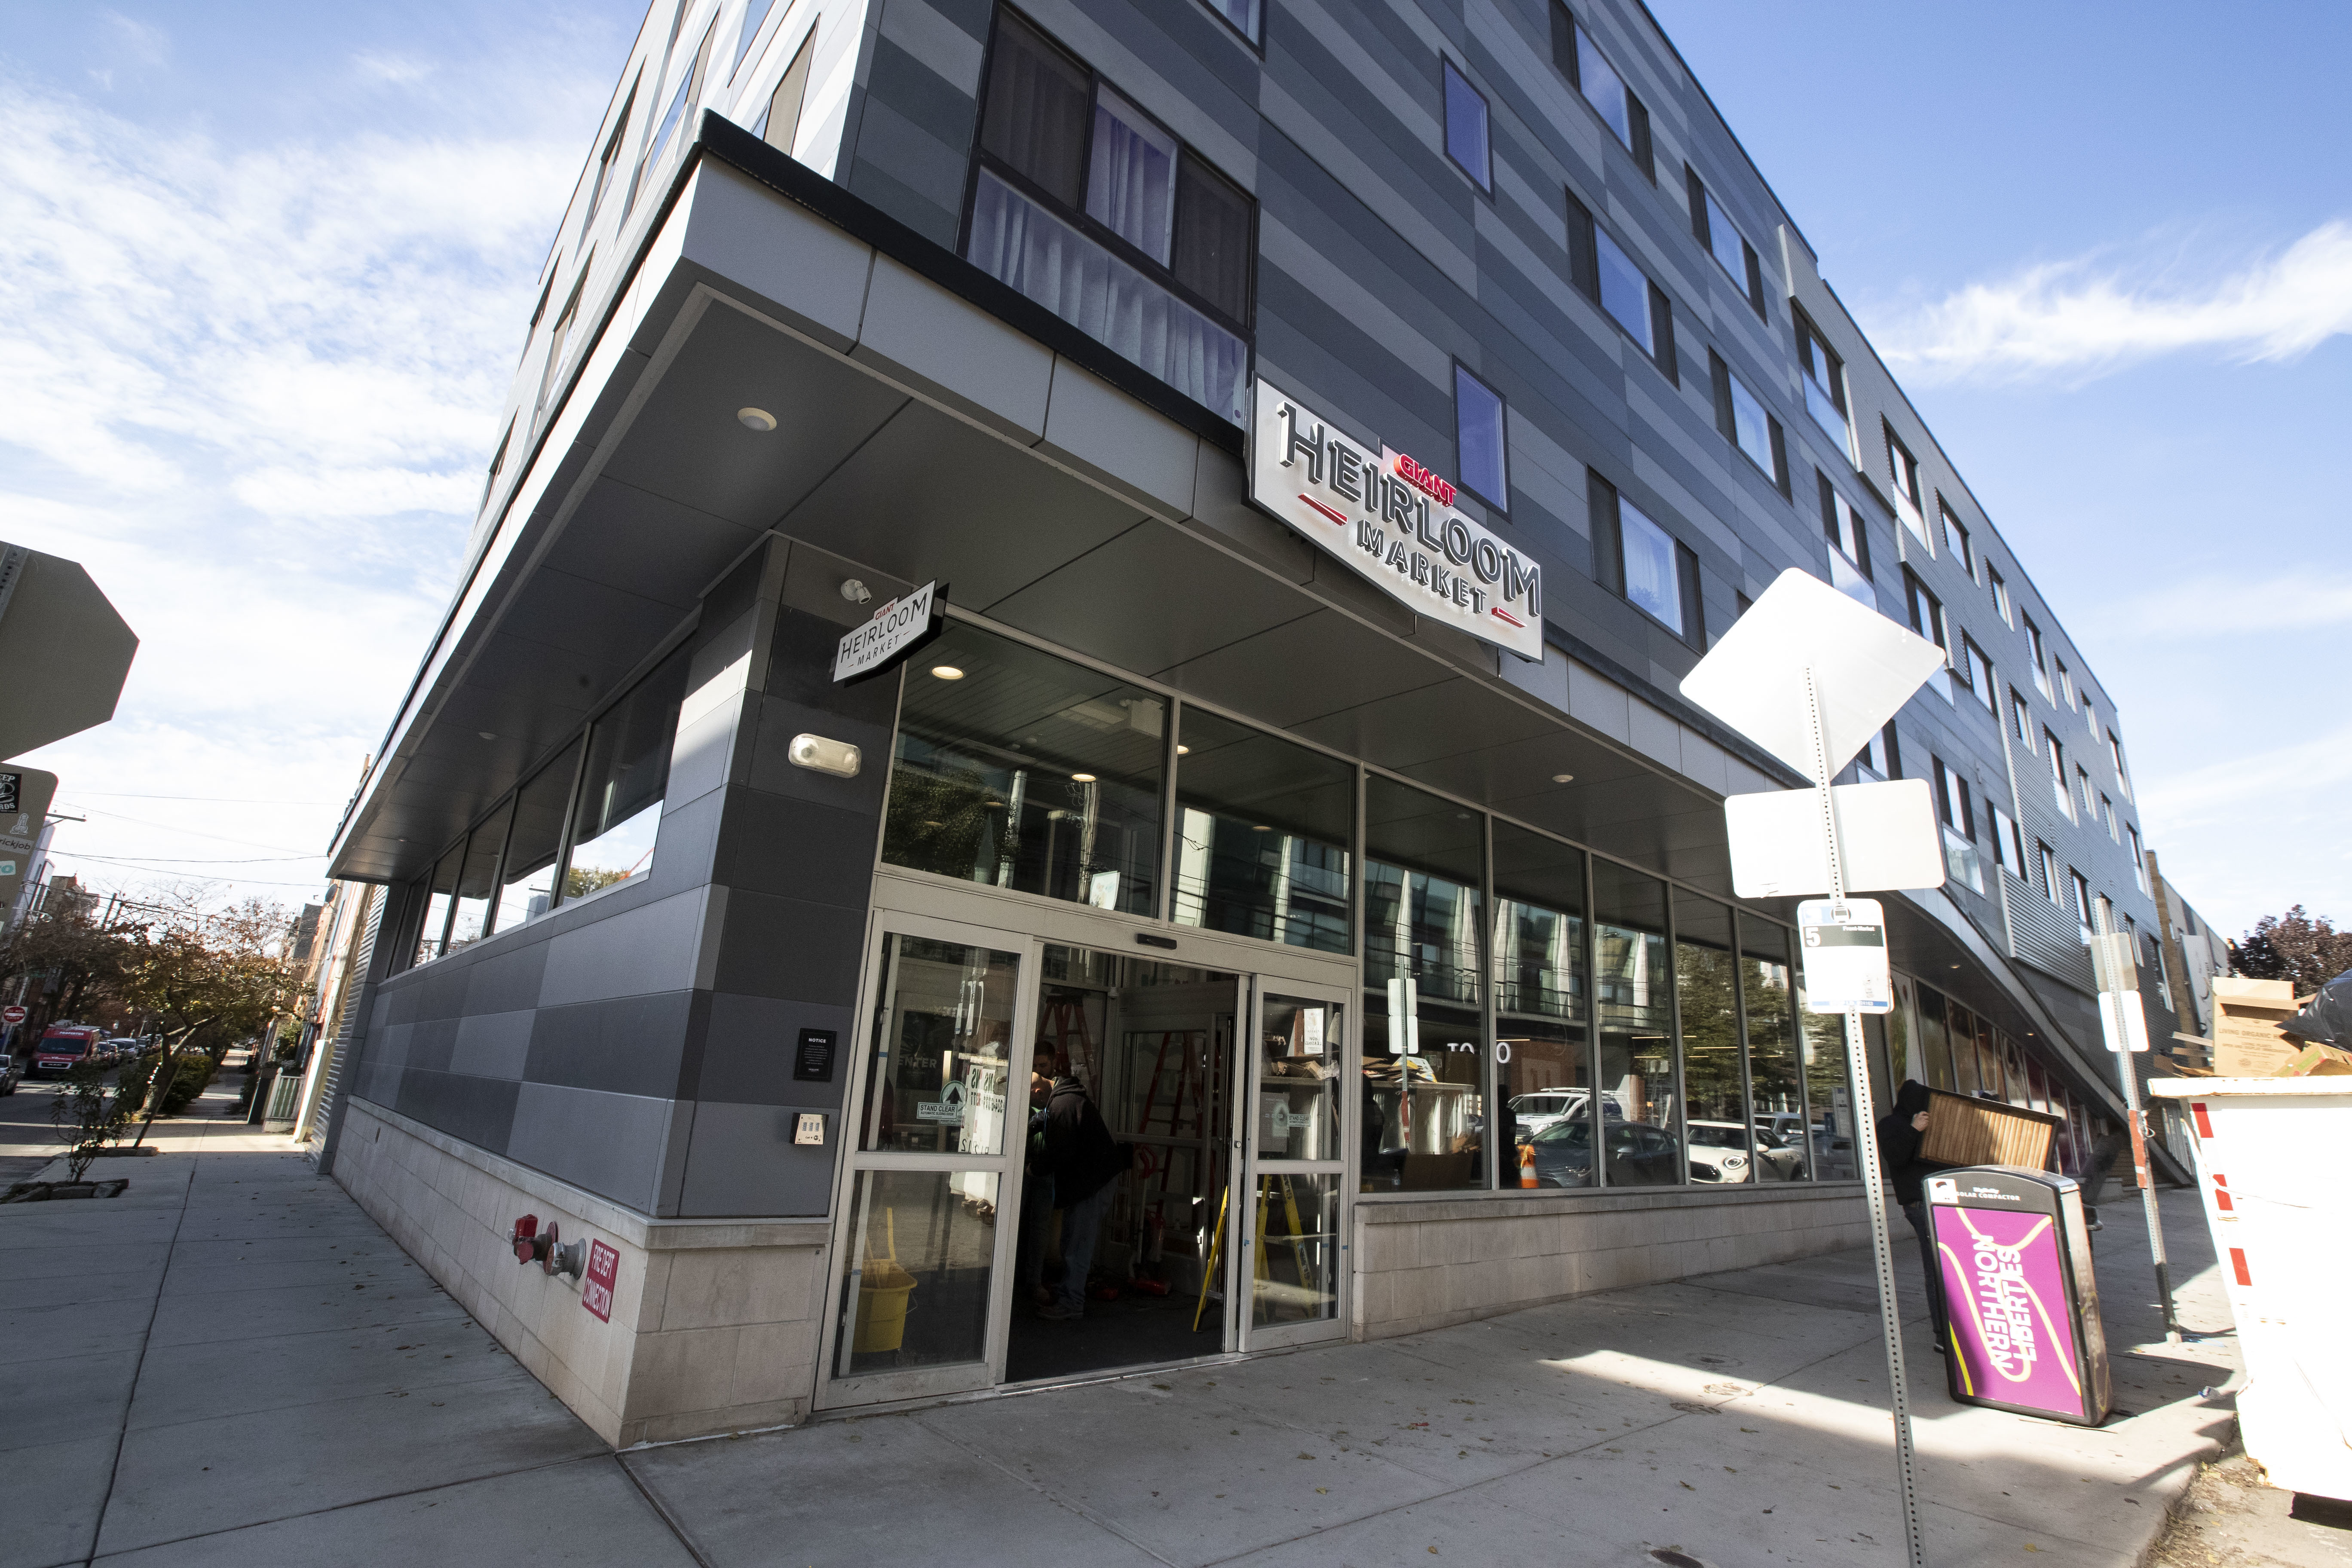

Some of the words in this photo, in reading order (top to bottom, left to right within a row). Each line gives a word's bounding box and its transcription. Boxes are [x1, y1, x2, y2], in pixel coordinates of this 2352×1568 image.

[1393, 453, 1457, 507] GIANT
[1276, 400, 1540, 617] HEIRLOOM
[1357, 519, 1488, 614] MARKET
[840, 592, 928, 663] HEIRLOOM
[875, 602, 895, 621] GIANT
[857, 634, 900, 666] MARKET
[1805, 926, 1821, 947] 5
[2242, 1030, 2271, 1038] ORGANIC
[1978, 1192, 2021, 1201] COMPACTOR
[591, 1244, 603, 1273] FIRE
[601, 1250, 615, 1280] DEPT
[583, 1277, 612, 1318] CONNECTION
[1971, 1234, 2014, 1369] NORTHERN
[1997, 1247, 2037, 1362] LIBERTIES
